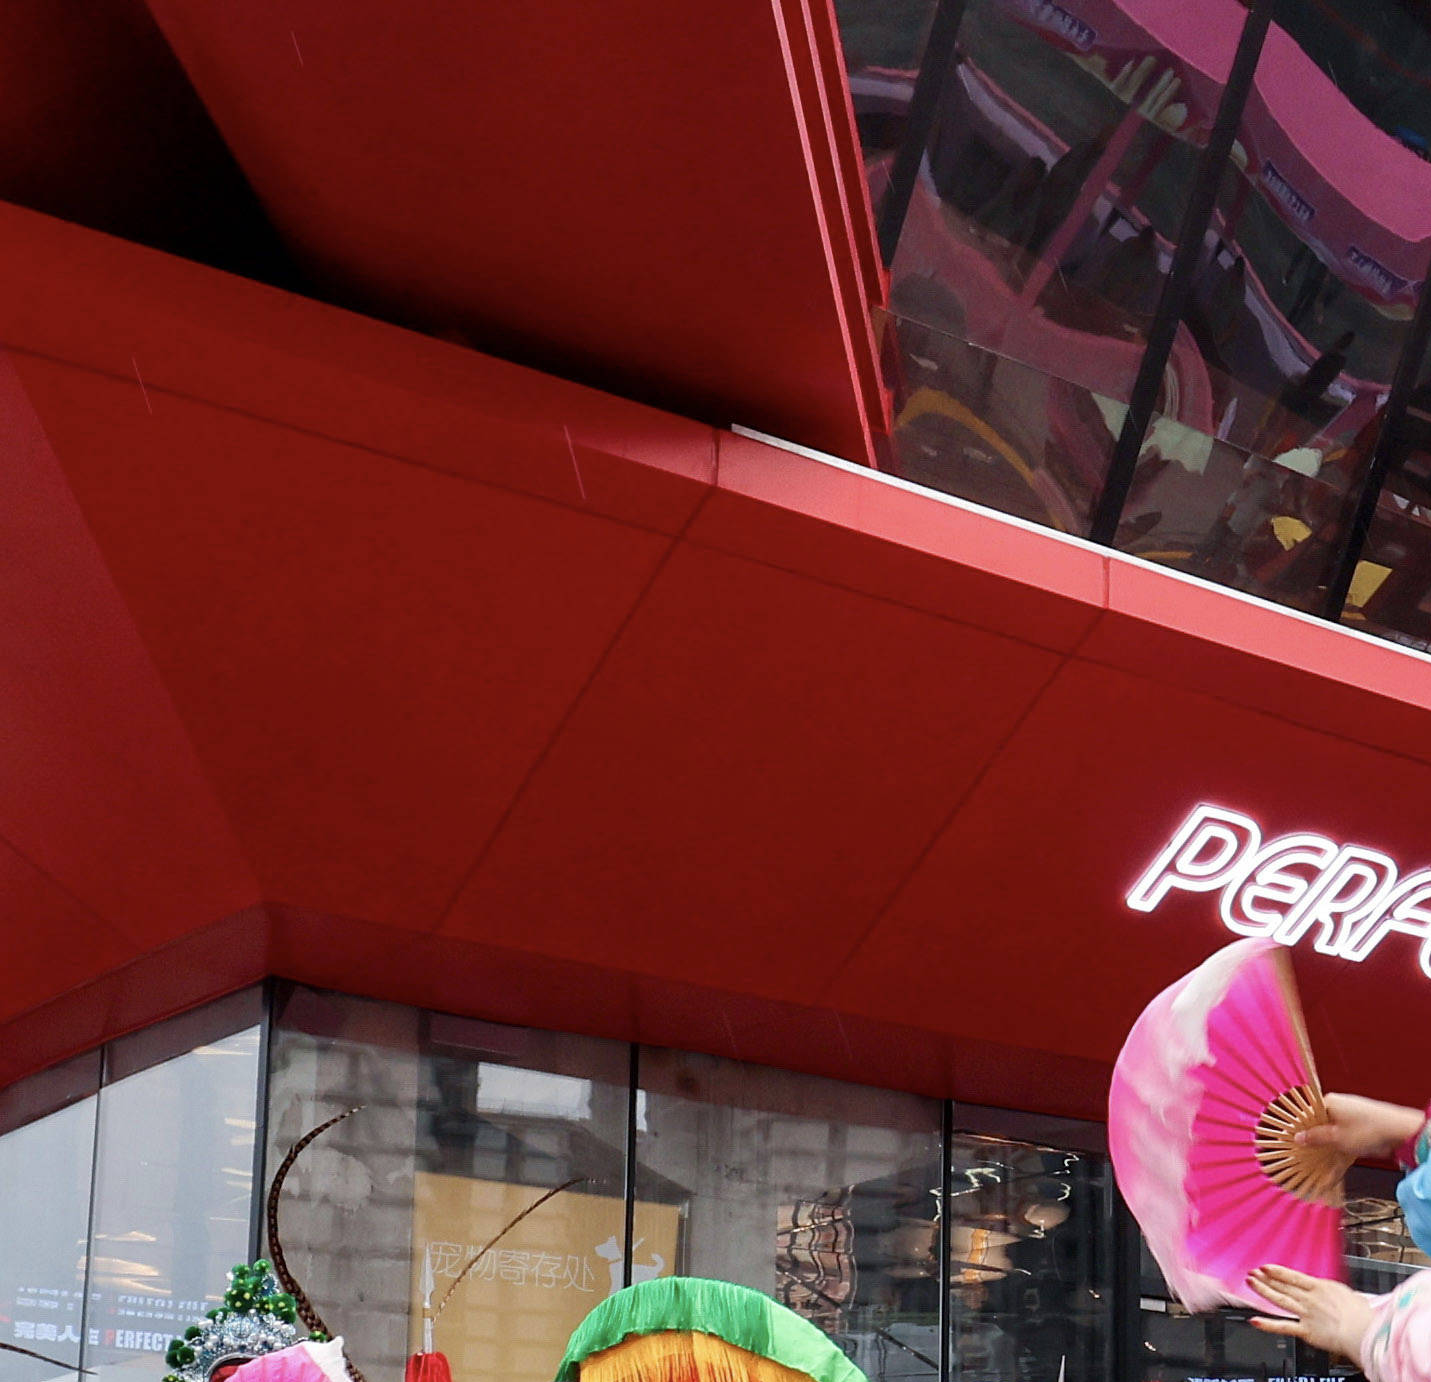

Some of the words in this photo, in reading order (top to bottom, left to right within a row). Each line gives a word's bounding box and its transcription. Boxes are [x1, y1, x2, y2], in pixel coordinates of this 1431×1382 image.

[430, 1240, 595, 1293] 宠物寄存处
[104, 1328, 173, 1352] PERFECT
